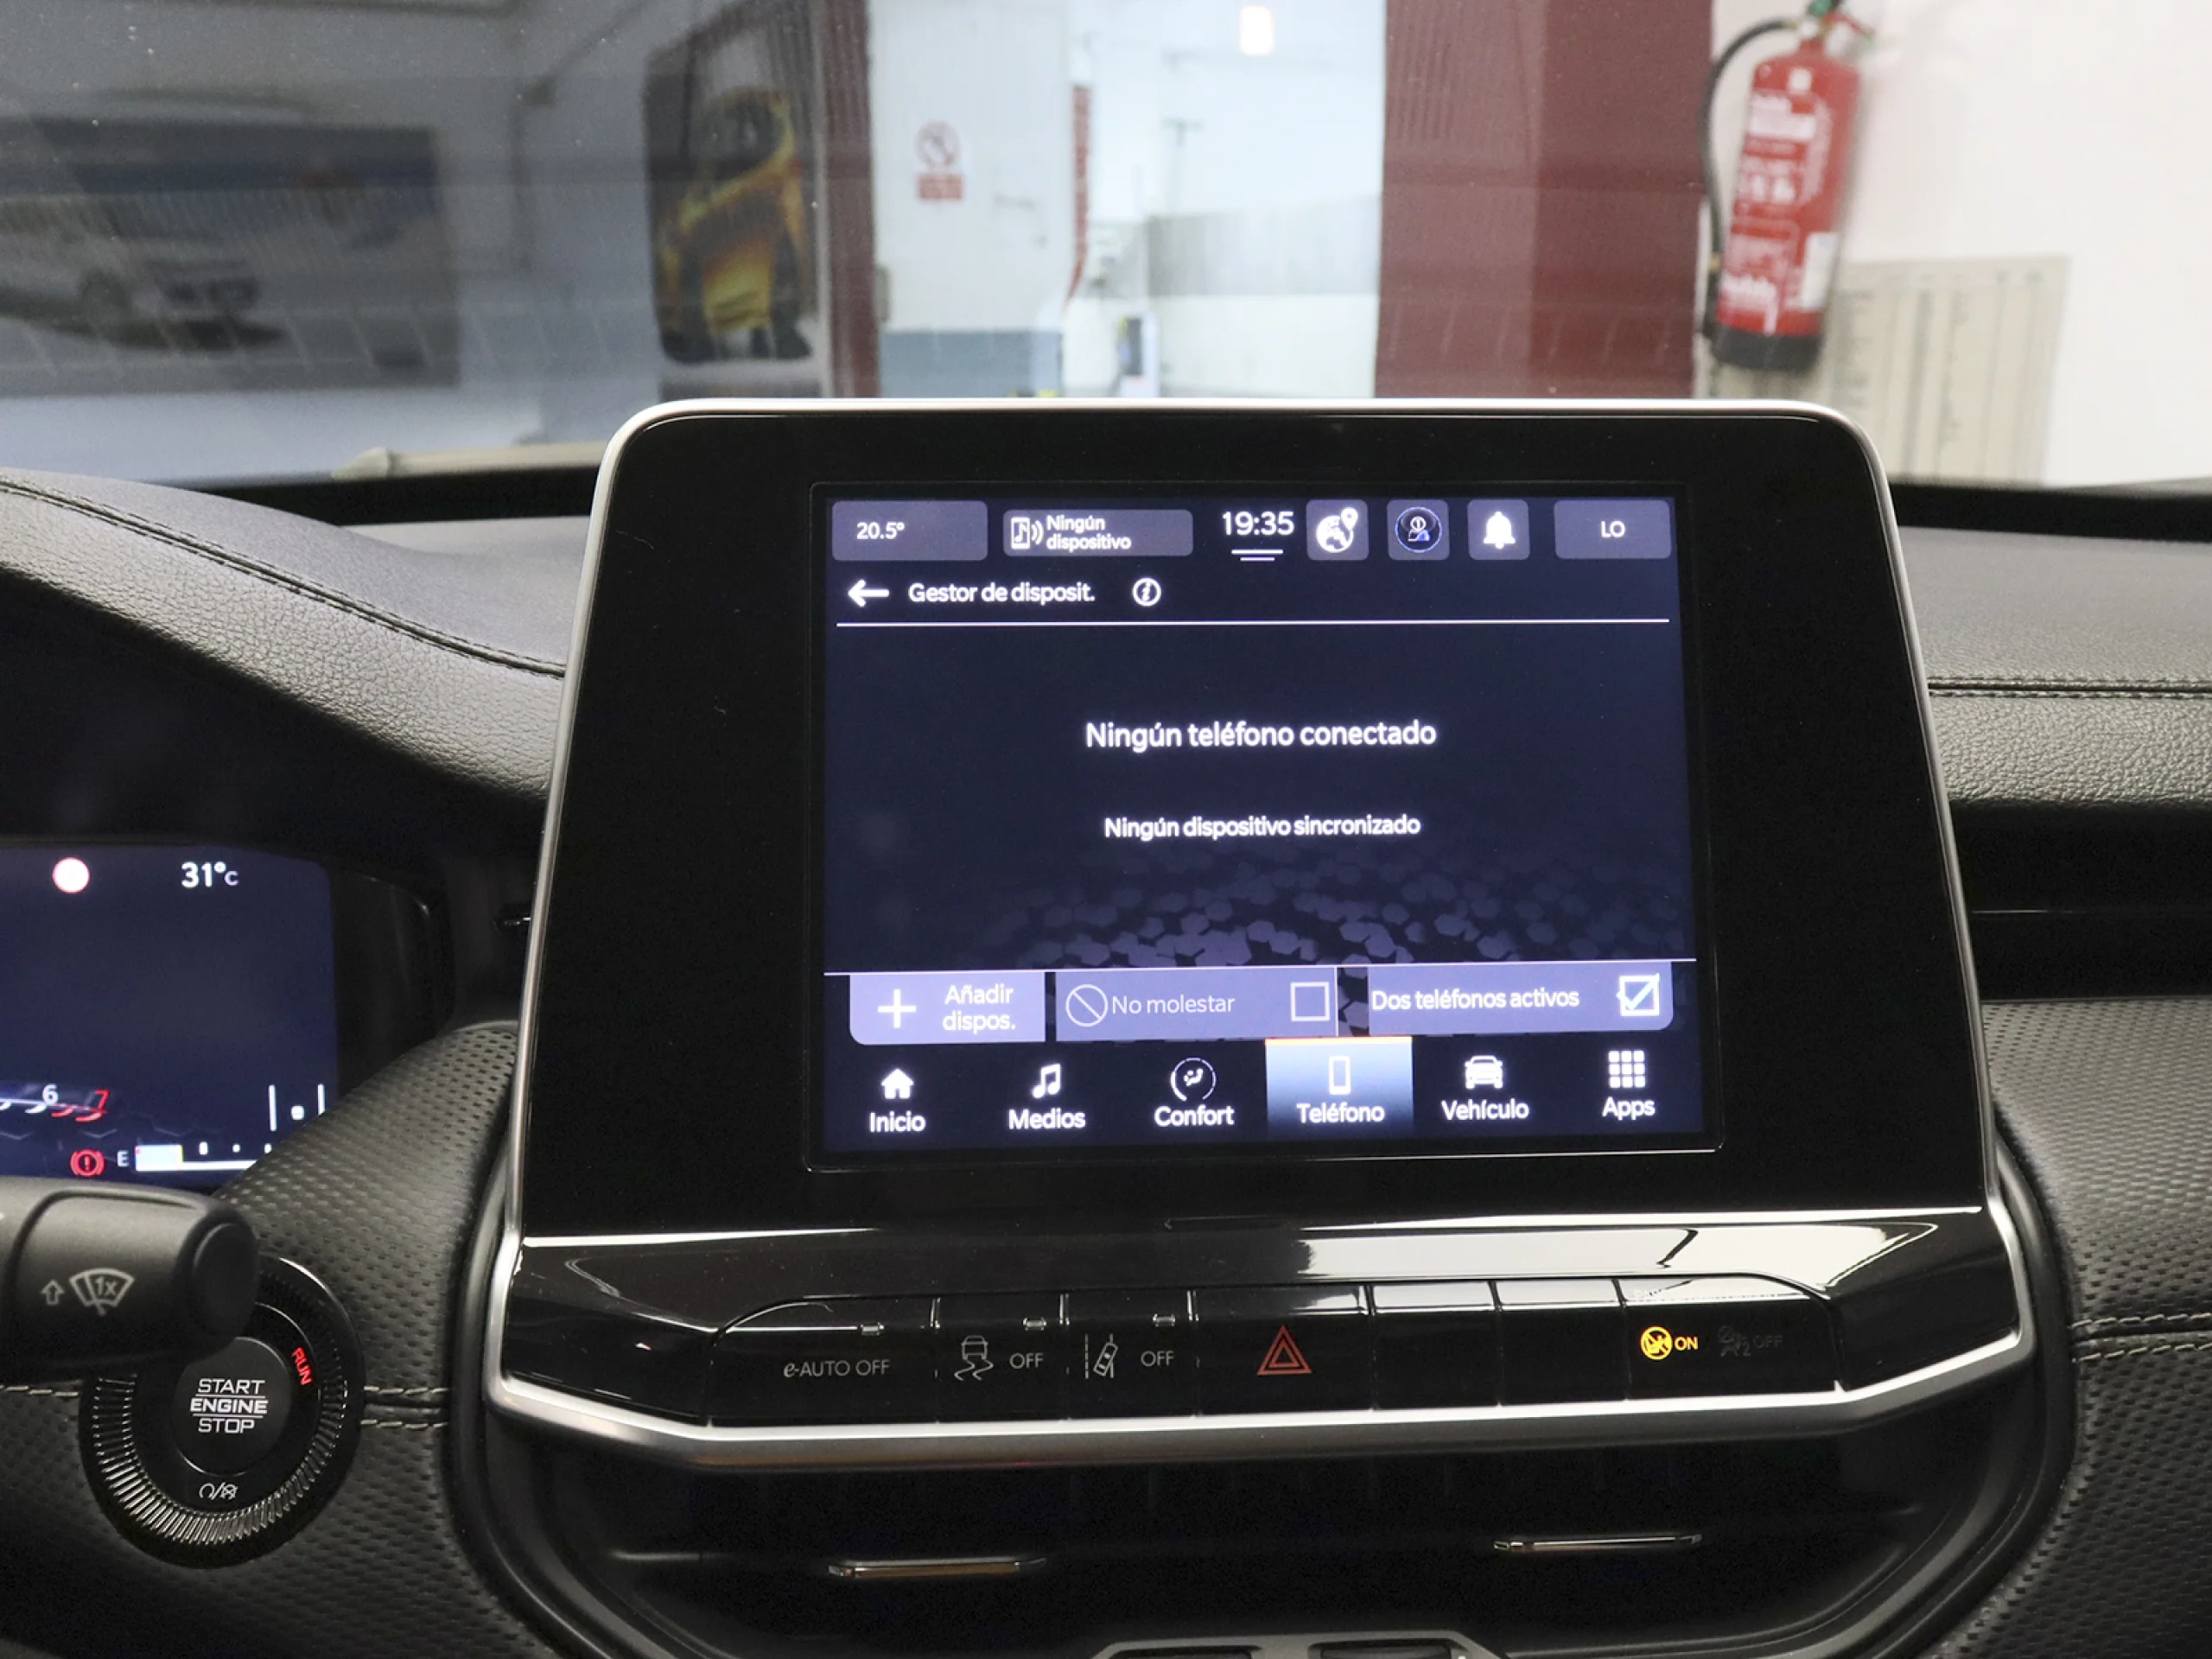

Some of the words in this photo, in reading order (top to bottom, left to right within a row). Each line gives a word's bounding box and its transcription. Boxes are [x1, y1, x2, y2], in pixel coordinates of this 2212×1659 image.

[1046, 515, 1105, 532] Ningún
[1223, 511, 1294, 536] 19:35
[1601, 520, 1625, 537] LO
[1046, 533, 1132, 553] dispositivo
[909, 583, 976, 603] Gestor
[981, 582, 1007, 603] de
[1011, 582, 1096, 606] disposit.
[1085, 721, 1182, 753] Ningún
[1187, 721, 1294, 747] teléfono
[1300, 719, 1438, 746] conectado
[1105, 817, 1179, 841] Ningún
[1183, 816, 1291, 840] dispositivo
[1294, 814, 1421, 836] sincronizado
[944, 984, 1014, 1006] Añadir
[1112, 996, 1141, 1015] No
[1147, 995, 1236, 1014] molestar
[1371, 990, 1411, 1011] Dos
[1414, 988, 1507, 1010] teléfonos
[1510, 988, 1580, 1008] activos
[942, 1010, 1016, 1033] dispos.
[42, 1084, 59, 1105] 6
[93, 1090, 111, 1110] 7
[1154, 1105, 1236, 1127] Confort
[1296, 1101, 1385, 1124] Teléfono
[1441, 1098, 1529, 1121] Vehículo
[1602, 1097, 1656, 1120] Apps
[869, 1111, 926, 1133] Inicio
[1008, 1109, 1086, 1130] Medios
[117, 1150, 129, 1166] E
[1675, 1336, 1699, 1351] ON
[1752, 1334, 1783, 1349] OFF
[291, 1347, 315, 1386] RUN
[783, 1361, 851, 1378] e-AUTO
[855, 1359, 891, 1376] OFF
[1009, 1352, 1044, 1370] OFF
[1141, 1351, 1174, 1368] OFF
[198, 1378, 265, 1395] START
[190, 1398, 269, 1414] ENGINE
[198, 1419, 255, 1434] STOP
